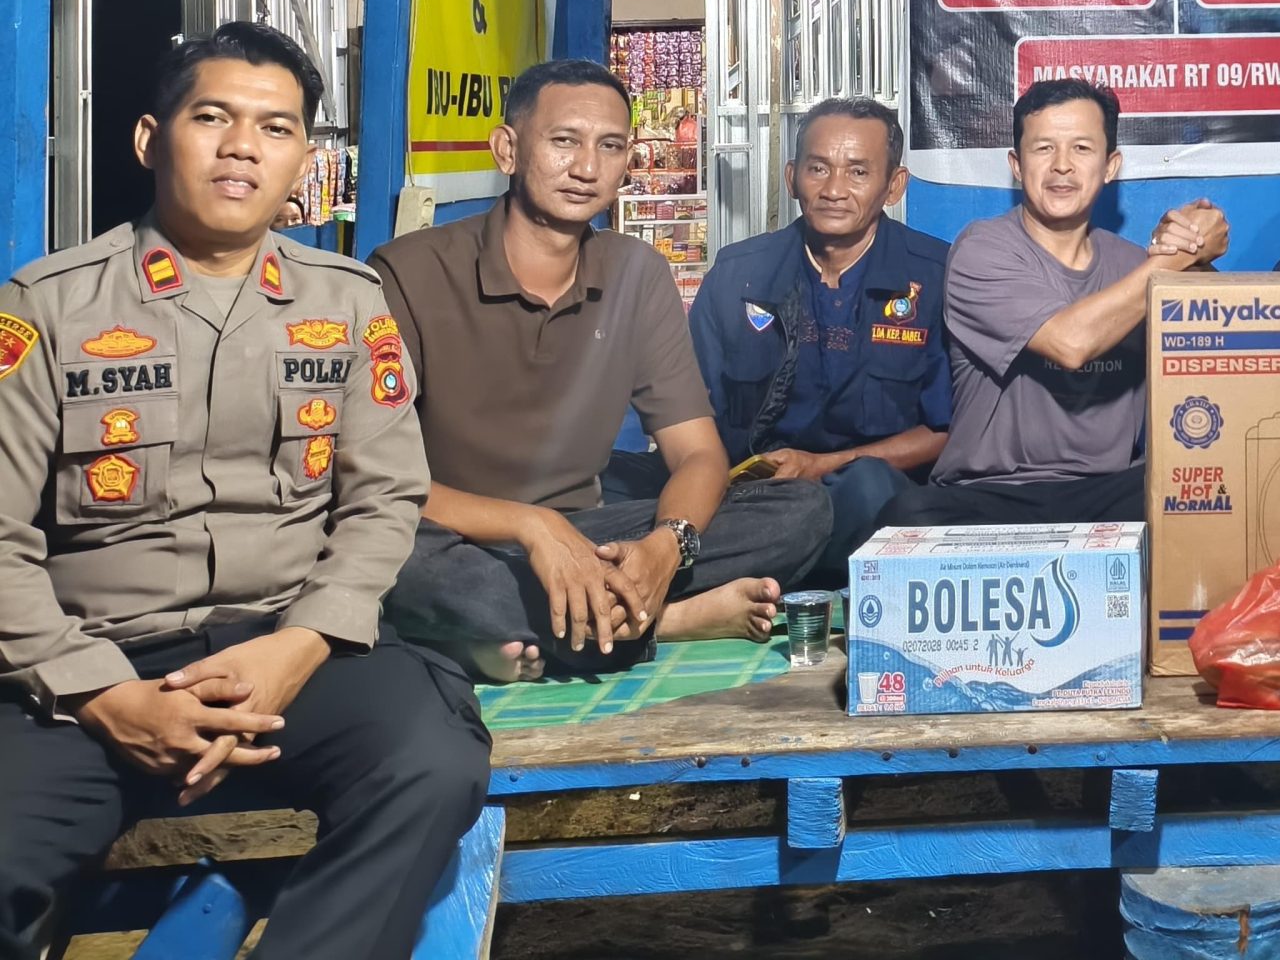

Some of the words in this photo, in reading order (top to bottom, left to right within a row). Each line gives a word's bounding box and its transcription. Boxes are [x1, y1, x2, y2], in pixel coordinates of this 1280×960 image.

[1033, 64, 1176, 88] MASYARAKAT
[1185, 65, 1210, 86] RT
[426, 68, 493, 118] IBU-IBU
[1164, 335, 1212, 348] WD-189
[1215, 336, 1224, 347] H
[66, 363, 172, 397] M.SYAH
[283, 357, 353, 384] POLRI
[1172, 467, 1224, 483] SUPER
[1181, 484, 1212, 500] HOT
[1217, 484, 1227, 495] &
[908, 576, 1051, 633] BOLESA
[965, 663, 993, 674] untuk
[994, 657, 1035, 678] Keluarga
[878, 672, 905, 692] 48
